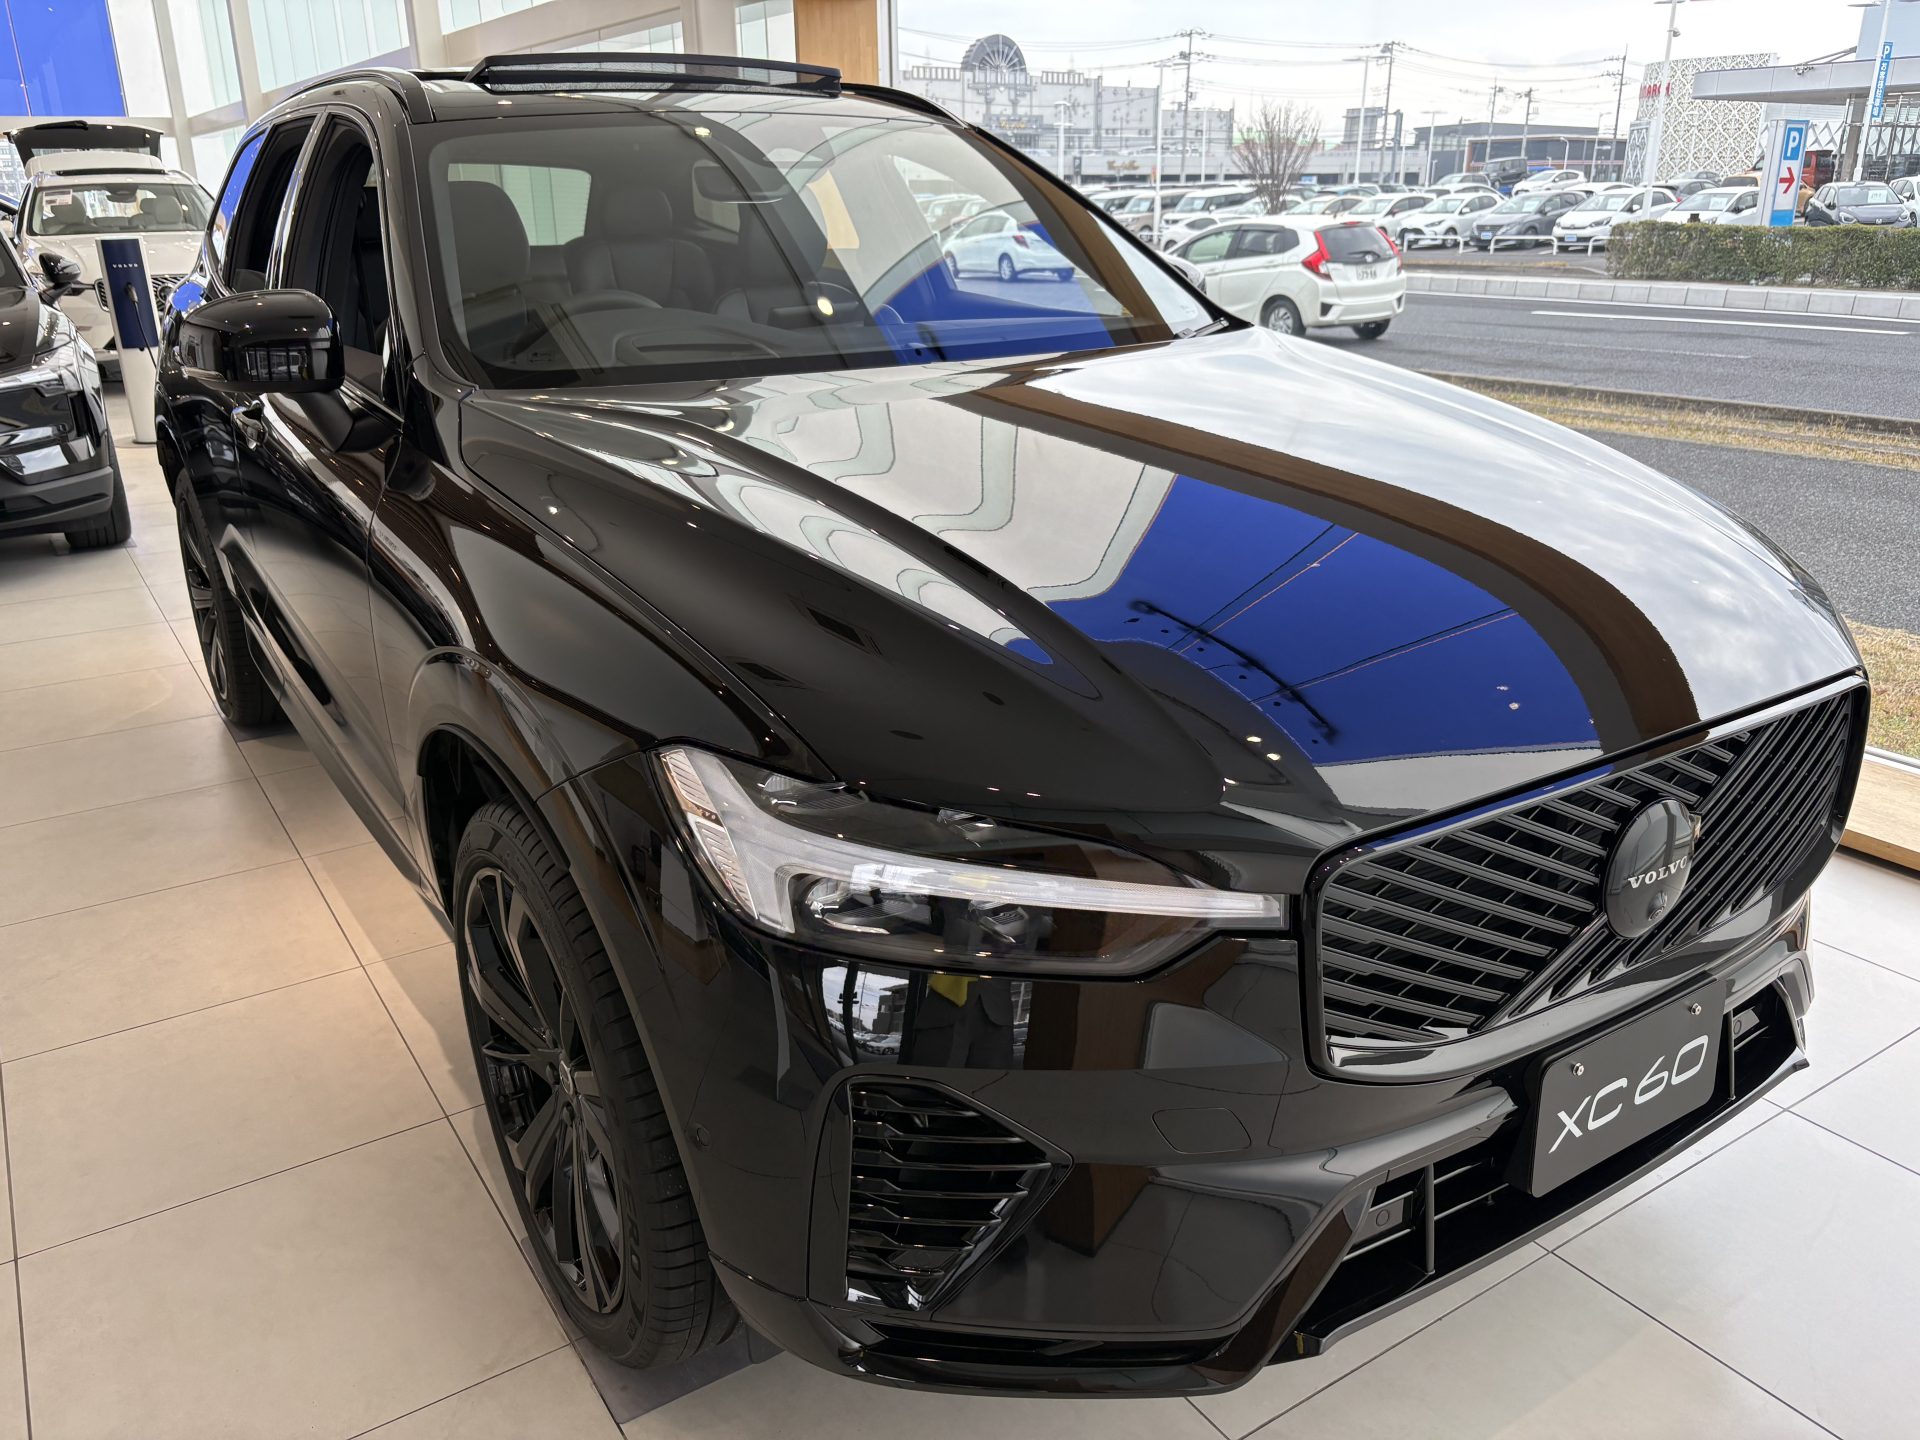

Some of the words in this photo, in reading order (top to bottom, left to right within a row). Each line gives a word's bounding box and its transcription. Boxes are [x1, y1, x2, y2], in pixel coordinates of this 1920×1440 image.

[1883, 45, 1890, 59] P
[1787, 130, 1800, 157] P
[1628, 855, 1688, 889] VOLVO
[1549, 1034, 1709, 1154] XC60
